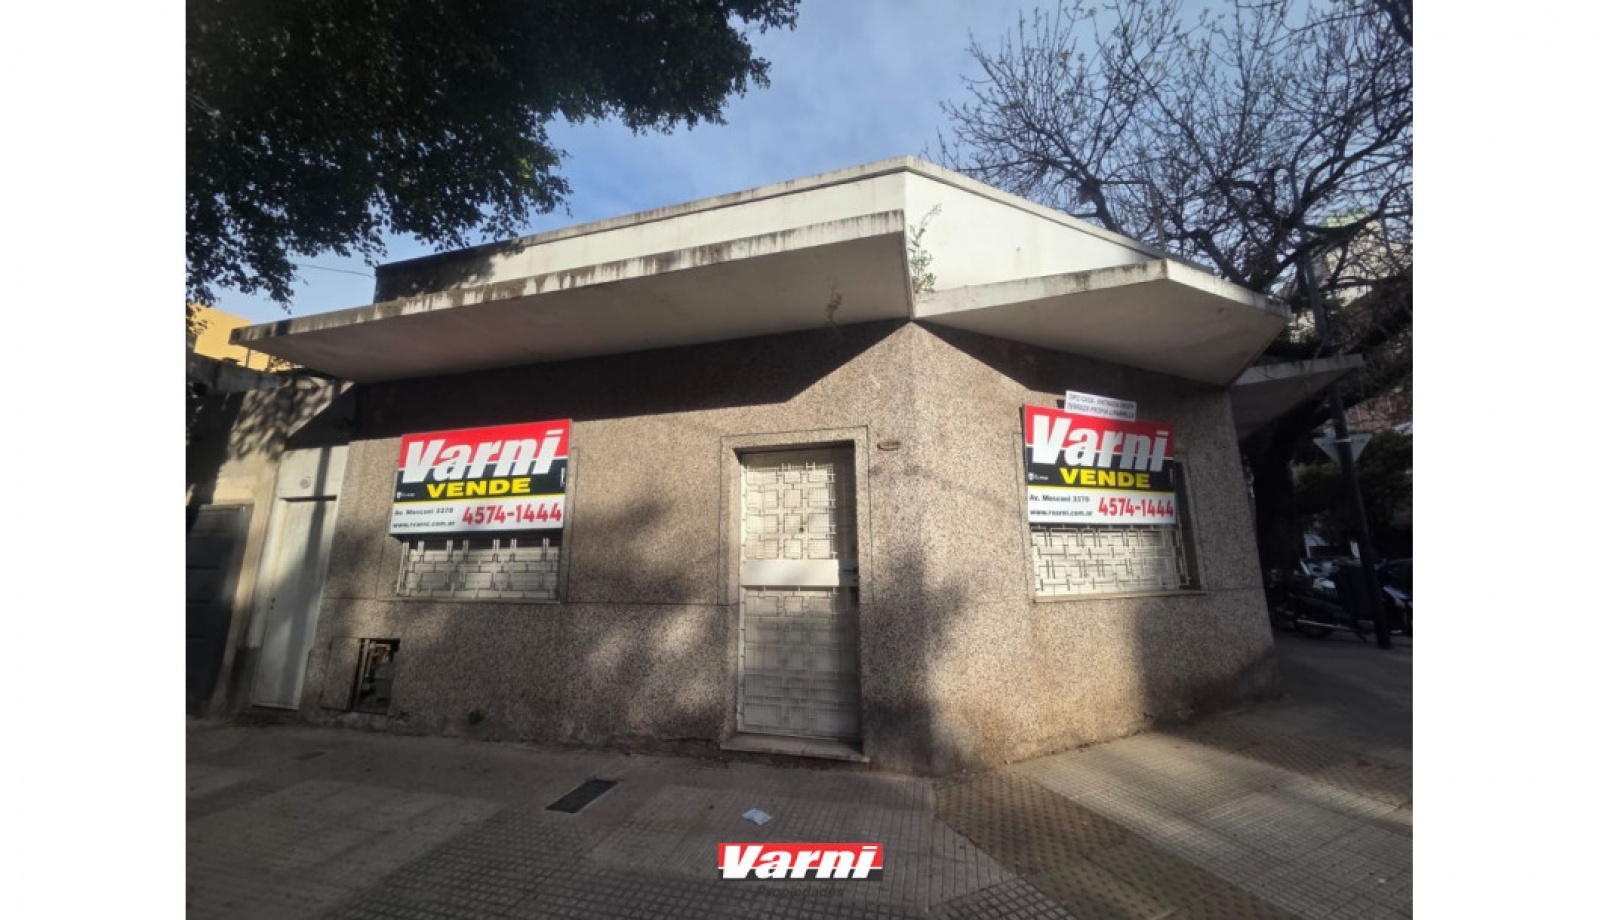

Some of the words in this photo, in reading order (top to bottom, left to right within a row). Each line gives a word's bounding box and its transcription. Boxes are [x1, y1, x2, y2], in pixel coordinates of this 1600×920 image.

[1032, 414, 1169, 472] Varni
[402, 429, 563, 483] Varni
[426, 477, 531, 499] VENDE
[1059, 467, 1151, 488] VENDE
[462, 503, 562, 525] 4574-1444
[1098, 497, 1174, 517] 4574-1444
